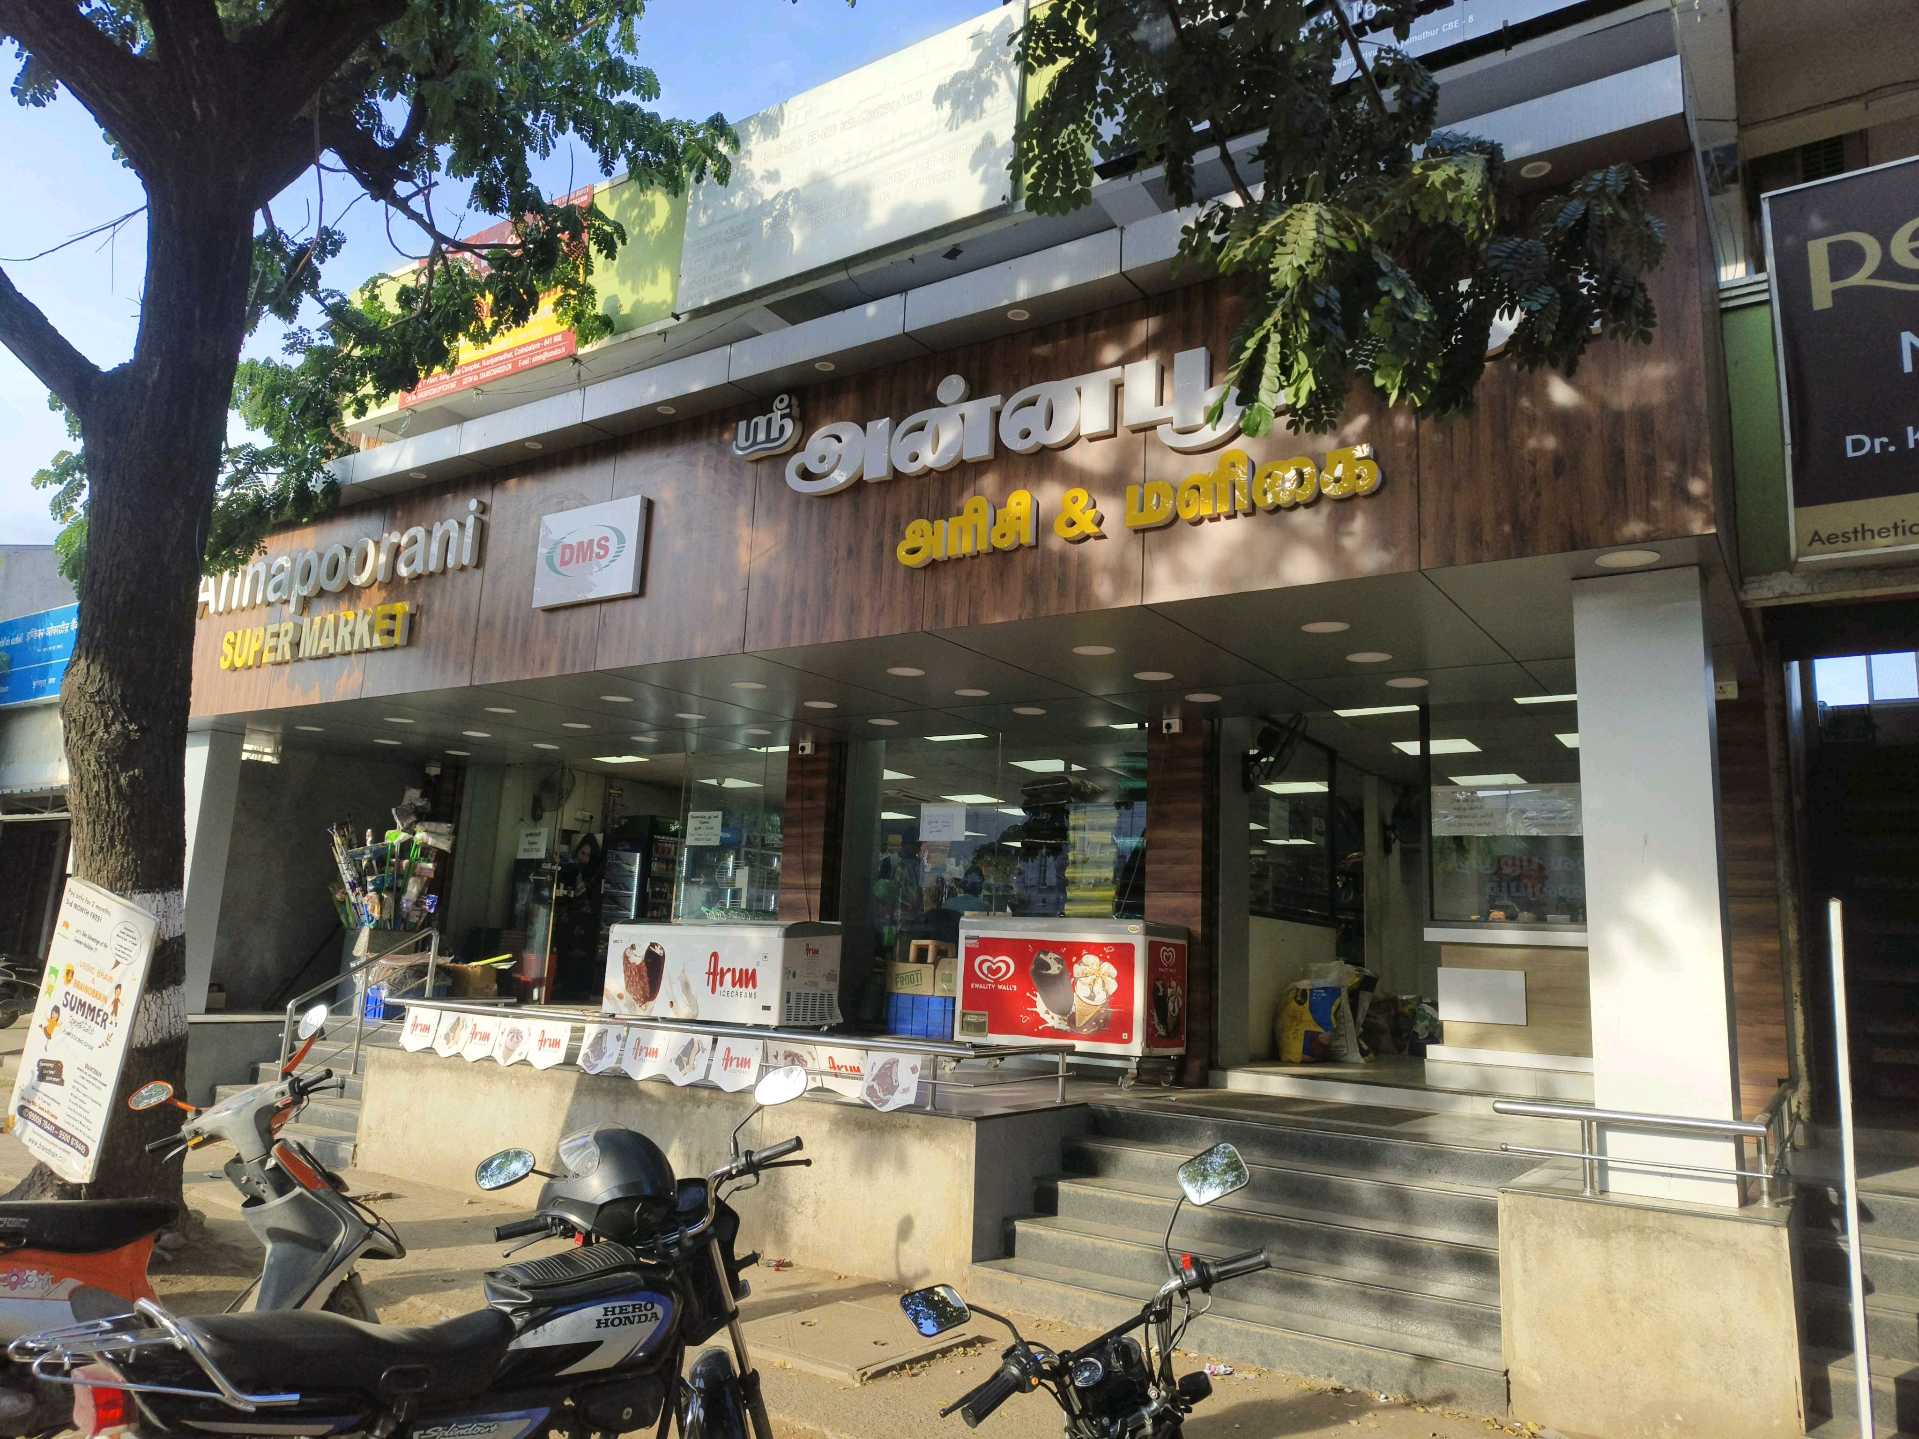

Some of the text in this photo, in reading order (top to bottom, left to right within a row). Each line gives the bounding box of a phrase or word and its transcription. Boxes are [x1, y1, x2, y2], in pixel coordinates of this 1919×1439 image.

[1442, 19, 1460, 33] CBE
[1845, 434, 1896, 458] Dr.
[896, 442, 1382, 569] அரிசி & மளிகை
[559, 535, 610, 567] DMS
[219, 600, 412, 671] SUPER MARKET
[705, 951, 758, 995] Arun
[62, 991, 109, 1030] SUMMER
[410, 1015, 431, 1035] Arun
[470, 1023, 491, 1044] Arun
[538, 1029, 561, 1051] Arun
[632, 1036, 659, 1059] Arun
[722, 1046, 752, 1071] Arun
[595, 1312, 661, 1329] HONDA
[602, 1302, 655, 1317] HERO
